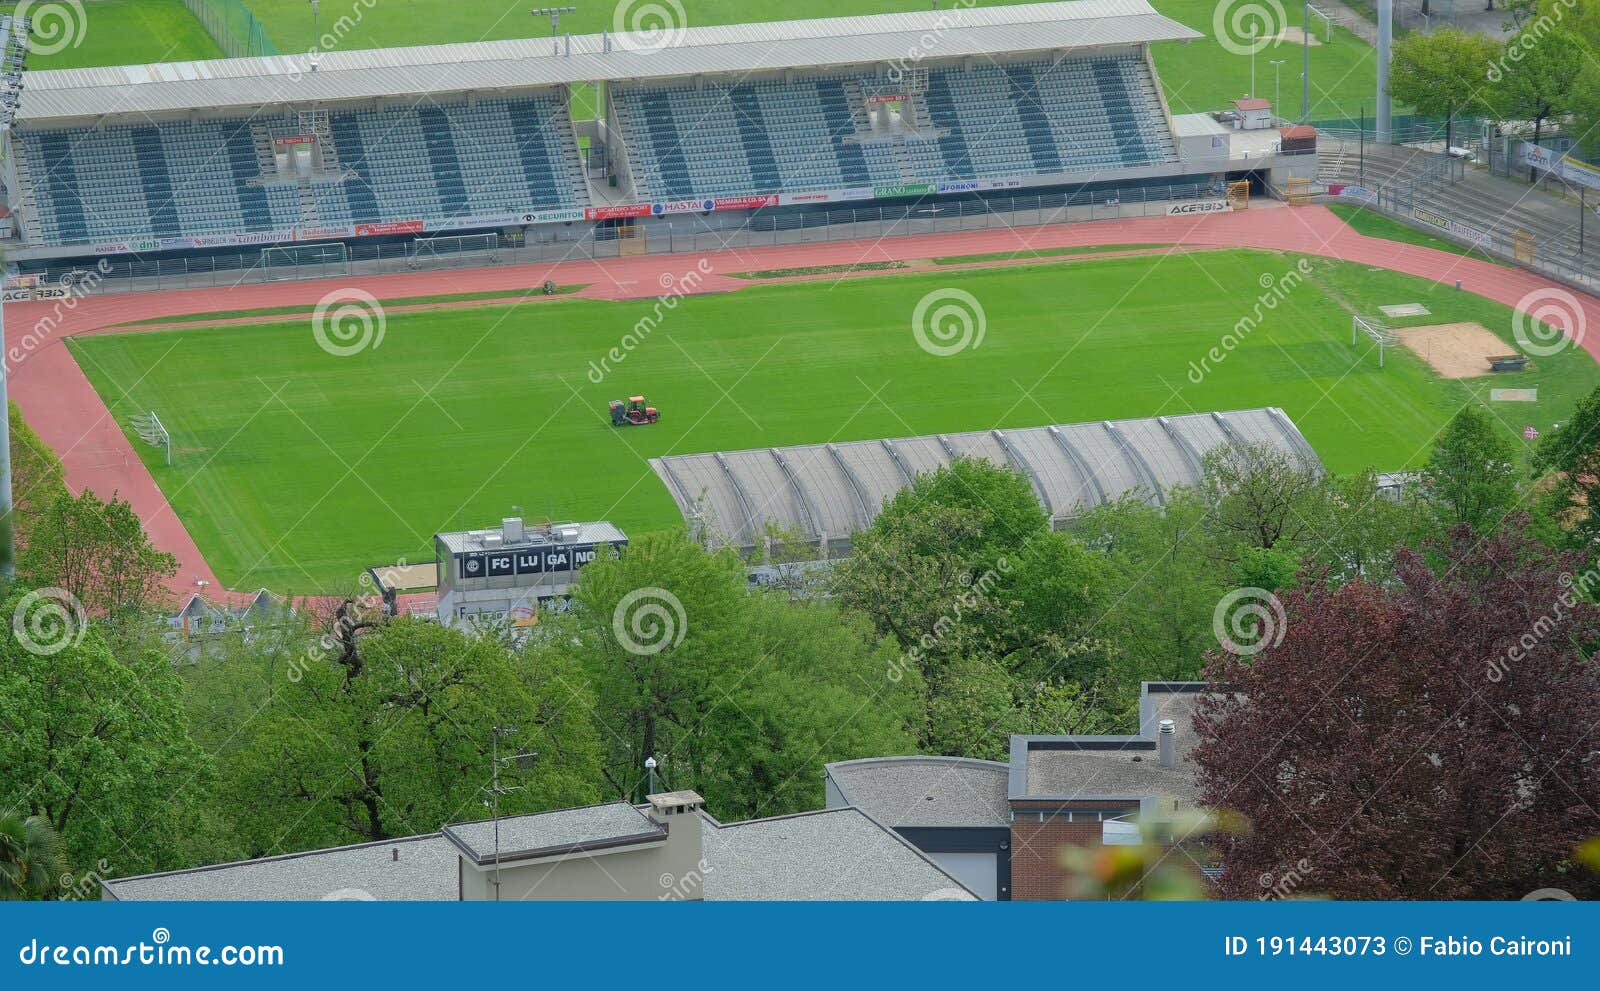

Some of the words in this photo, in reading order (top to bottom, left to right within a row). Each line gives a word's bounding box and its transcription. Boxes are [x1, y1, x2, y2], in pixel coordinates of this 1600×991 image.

[664, 200, 702, 210] MASTAI
[538, 211, 583, 221] SECURITON
[139, 240, 160, 250] dnb
[492, 557, 510, 570] FC
[520, 555, 538, 567] LU
[547, 553, 567, 565] GA
[575, 551, 596, 563] NO
